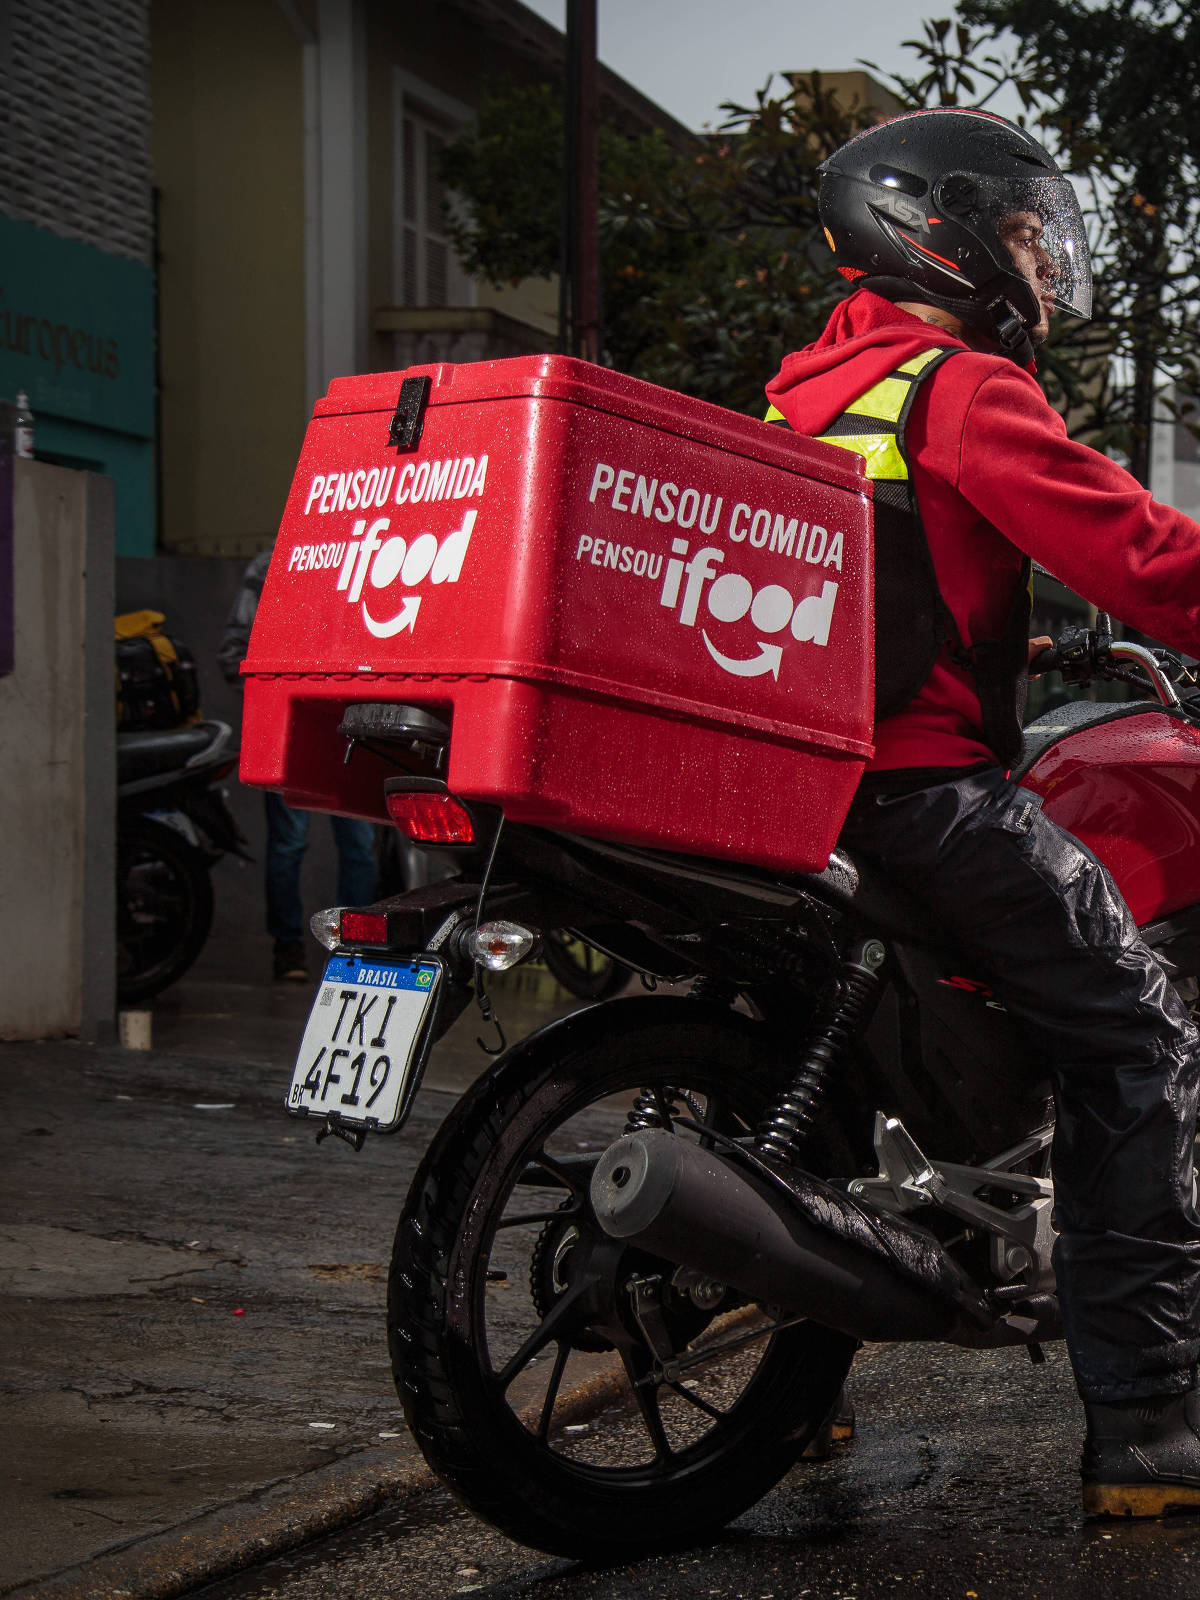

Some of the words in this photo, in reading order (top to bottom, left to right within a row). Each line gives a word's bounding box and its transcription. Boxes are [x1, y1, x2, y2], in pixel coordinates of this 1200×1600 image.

[0, 310, 120, 380] uropeus
[305, 465, 396, 515] PENSOU
[396, 455, 489, 505] COMIDA
[588, 463, 723, 535] PENSOU
[728, 503, 844, 571] COMIDA
[288, 541, 346, 571] PENSOU
[336, 510, 478, 603] ifood
[575, 534, 663, 580] PENSOU
[660, 537, 839, 646] ifood
[356, 968, 399, 987] BRASIL
[331, 990, 397, 1048] TKI
[290, 1083, 305, 1104] BR
[304, 1046, 391, 1108] 4F19
